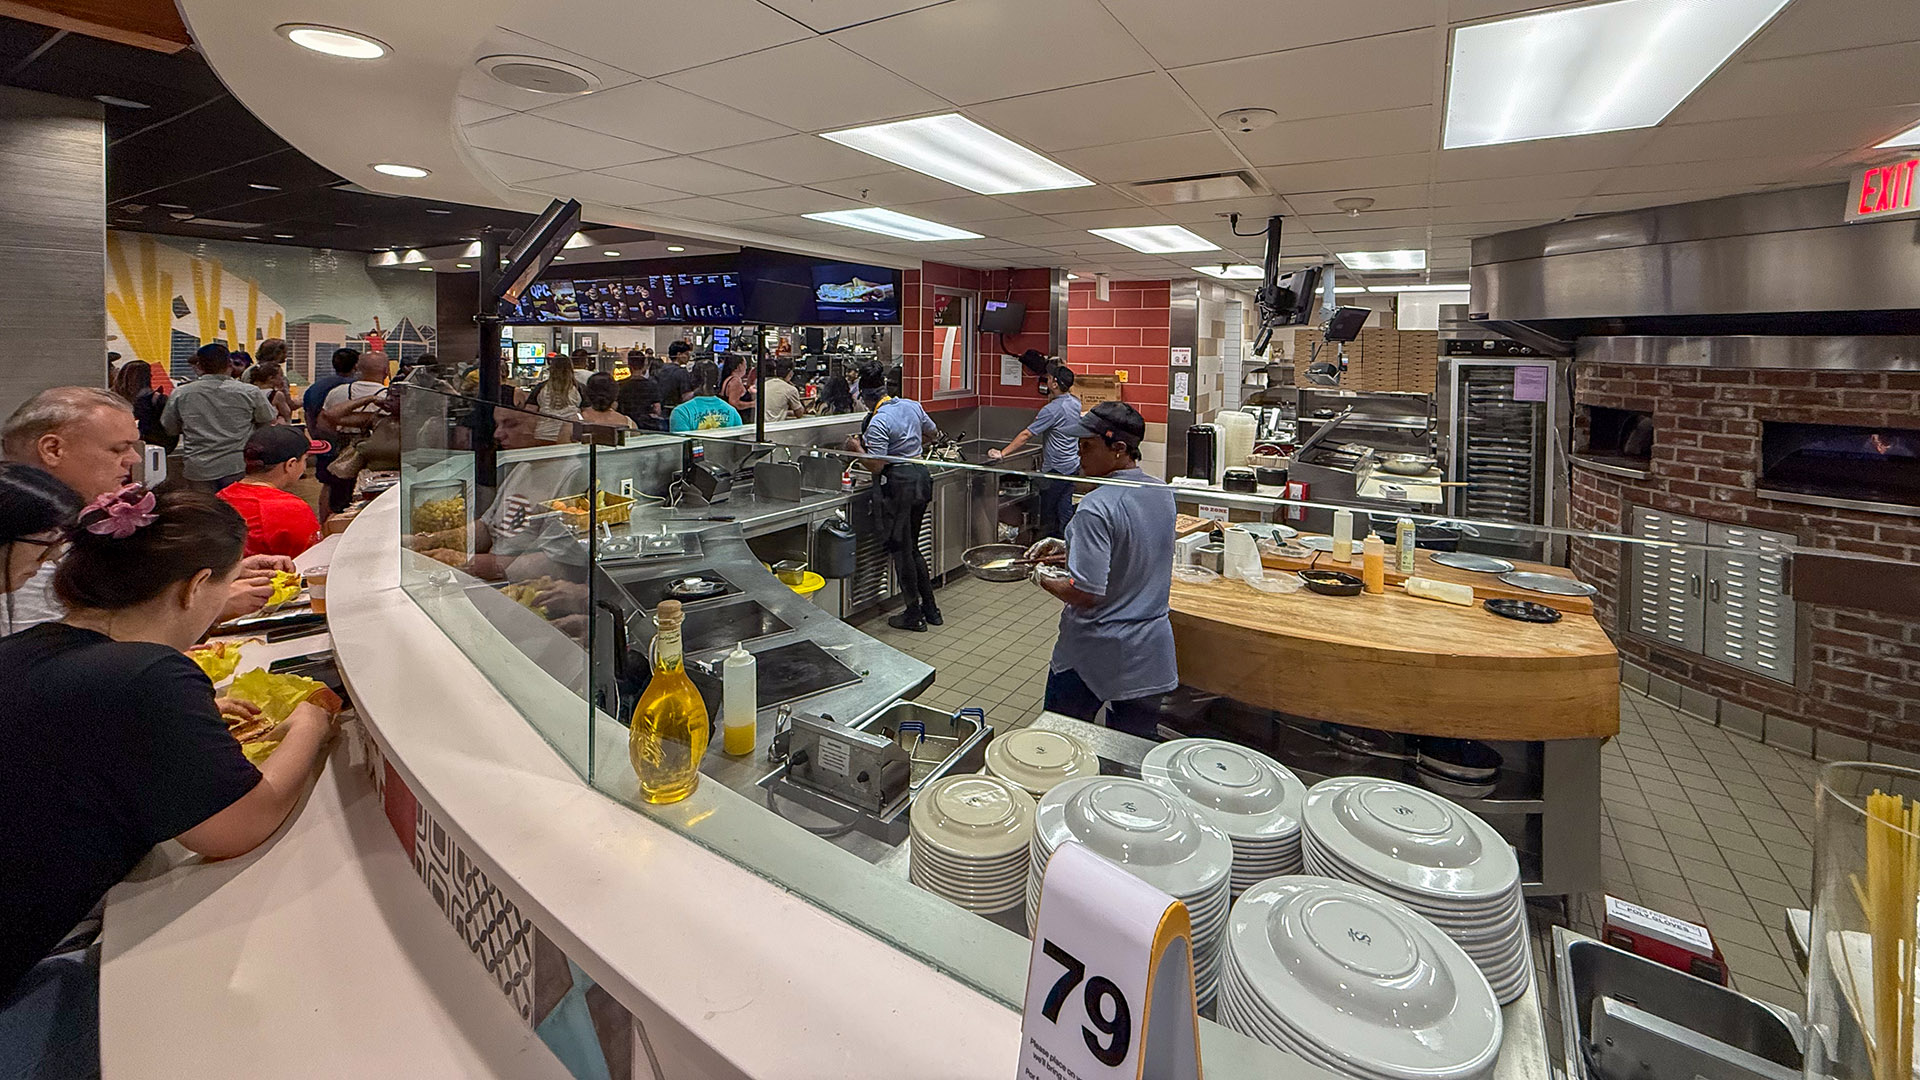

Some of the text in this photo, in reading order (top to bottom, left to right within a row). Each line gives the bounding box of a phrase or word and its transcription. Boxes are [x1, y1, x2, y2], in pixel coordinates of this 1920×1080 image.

[1858, 159, 1920, 215] EXIT
[529, 283, 551, 299] QPC
[1627, 907, 1649, 918] POLY
[1652, 915, 1690, 933] GLOVES
[1041, 937, 1132, 1068] 79
[1029, 1036, 1076, 1079] Please place on
[1046, 1061, 1063, 1080] bring
[1025, 1067, 1036, 1080] Por
